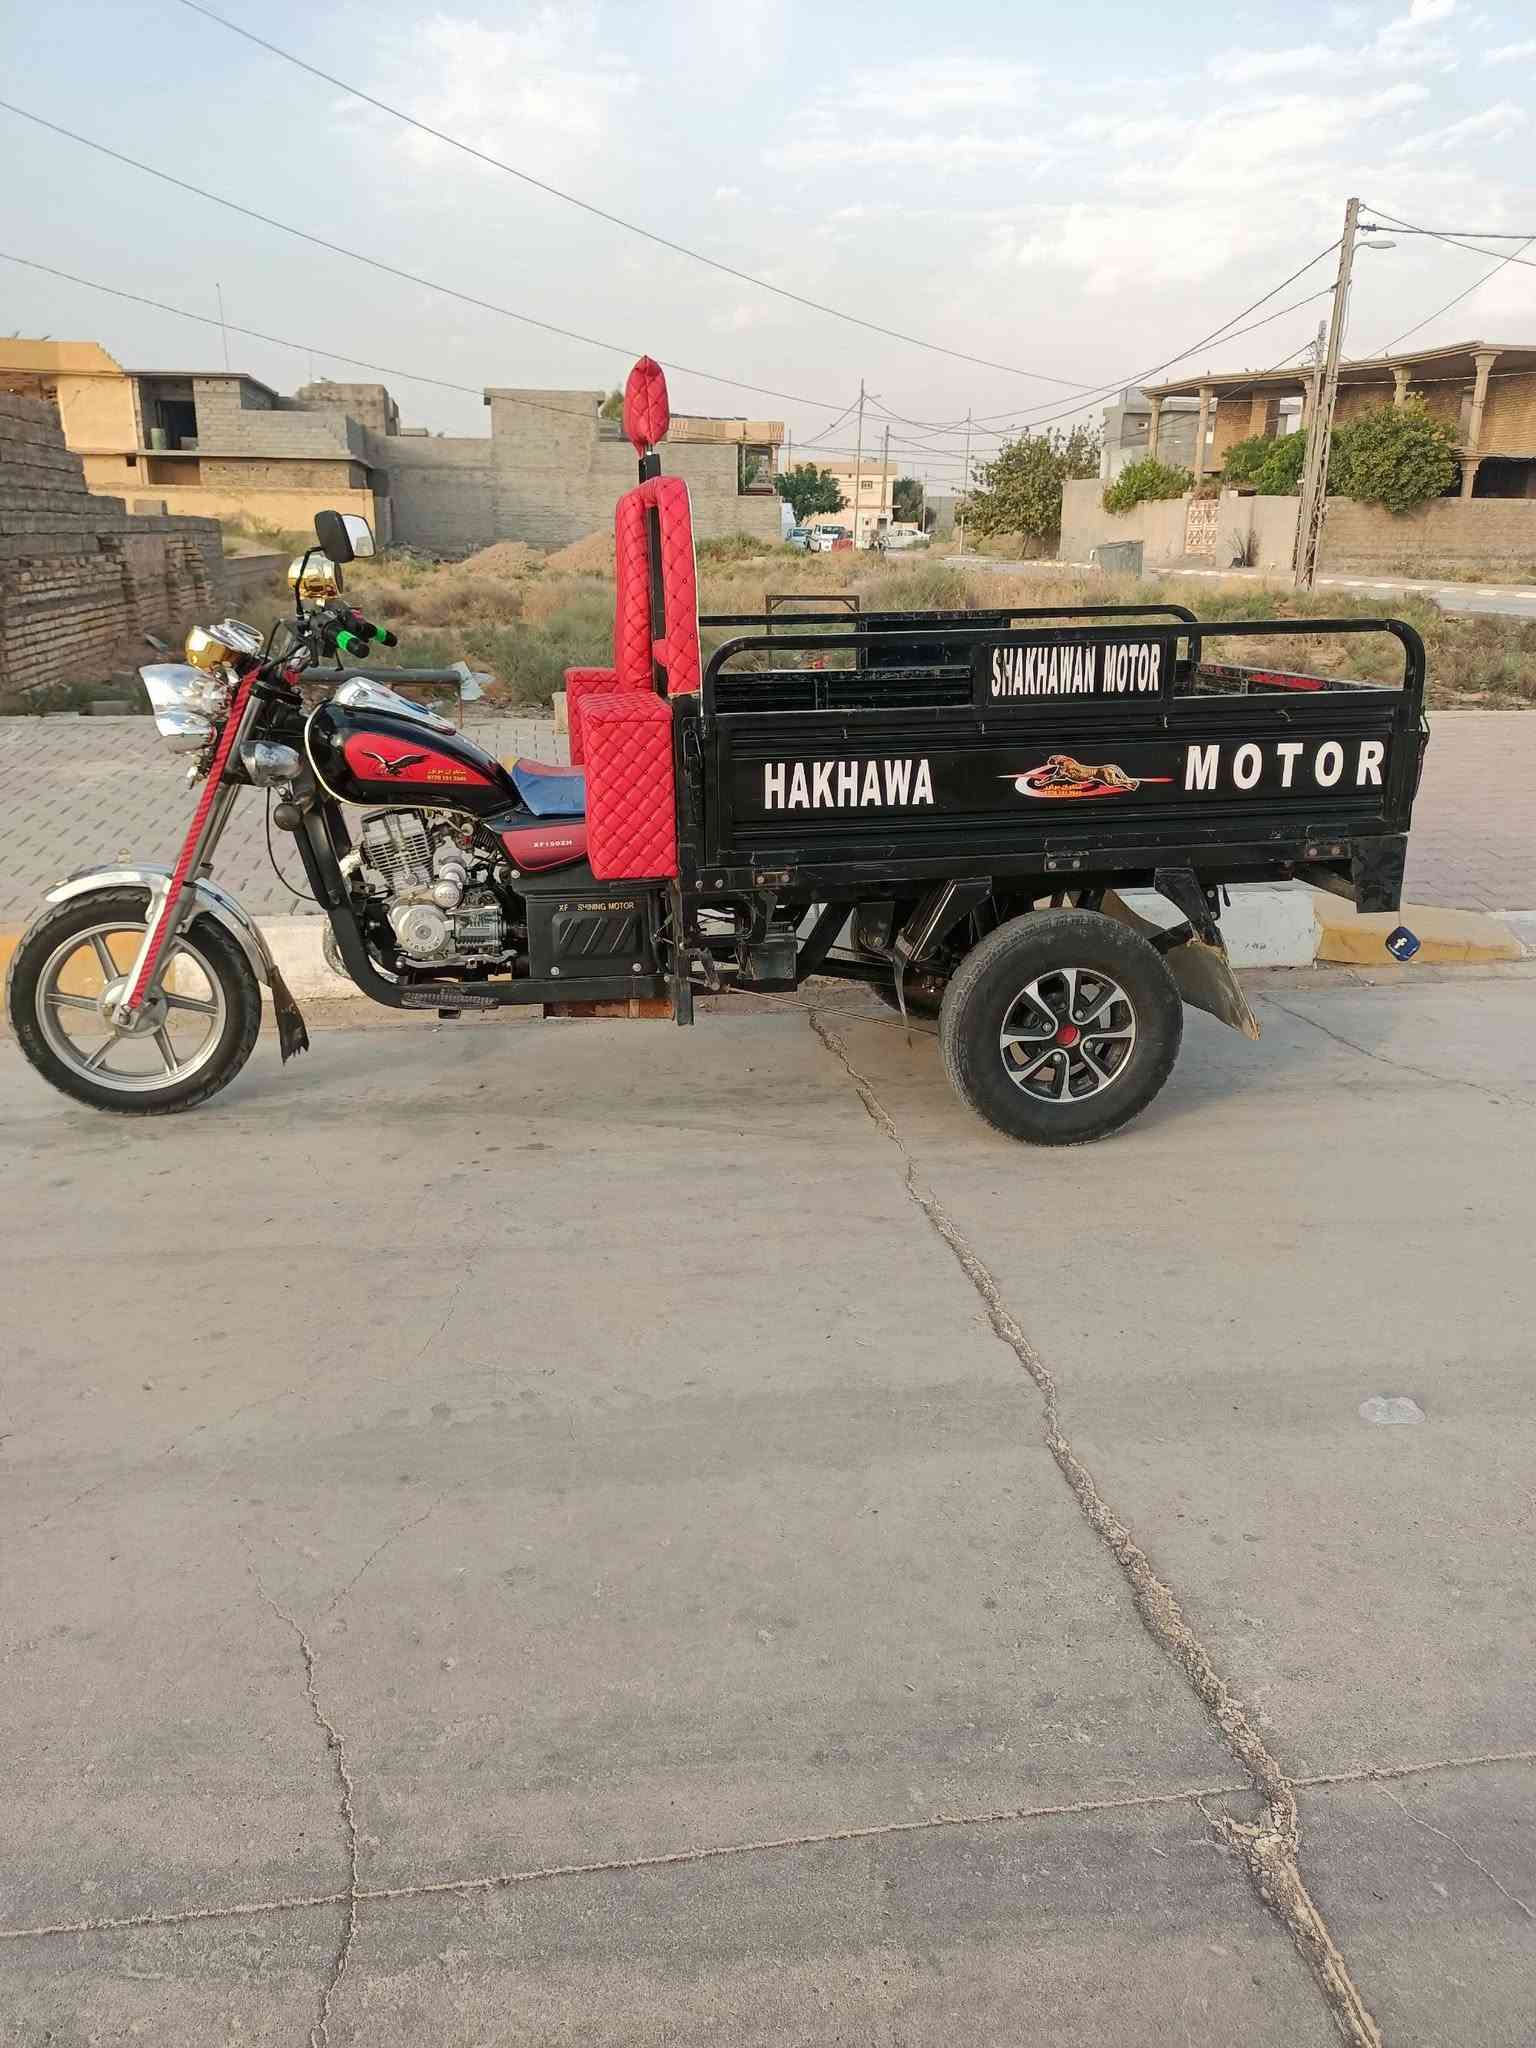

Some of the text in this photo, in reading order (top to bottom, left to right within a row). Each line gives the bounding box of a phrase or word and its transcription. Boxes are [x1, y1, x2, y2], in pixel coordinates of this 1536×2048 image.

[991, 644, 1161, 697] SHAKHAWAN MOTOR
[764, 741, 1385, 809] HAKHAWA MOTOR
[608, 901, 635, 910] MOTOR
